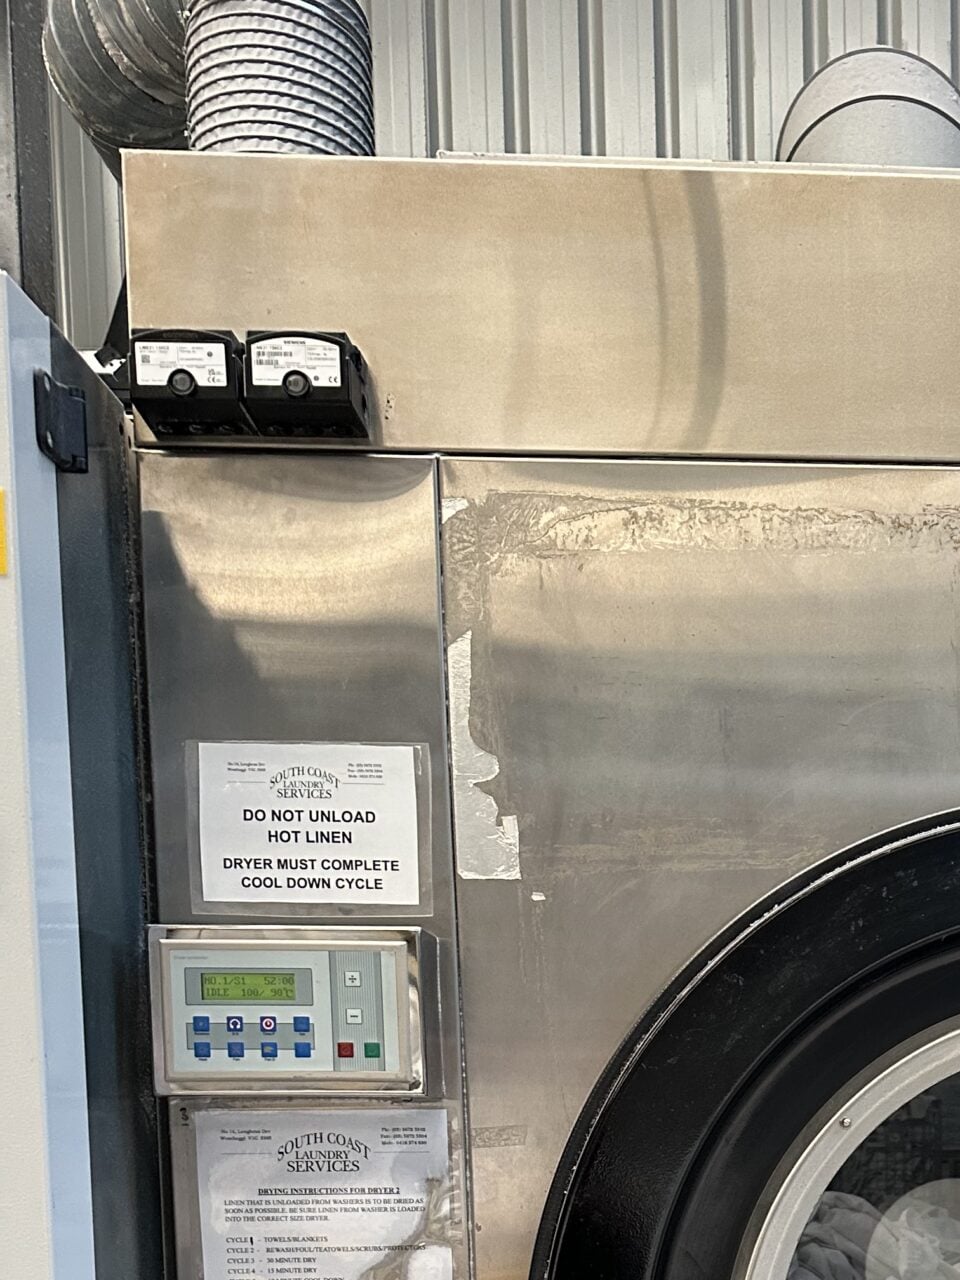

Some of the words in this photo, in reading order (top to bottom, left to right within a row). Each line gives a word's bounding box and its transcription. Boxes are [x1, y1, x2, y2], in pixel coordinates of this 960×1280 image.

[270, 766, 305, 790] SOUTH
[307, 766, 341, 789] COAST
[283, 780, 326, 789] LAUNDRY
[276, 788, 333, 799] SERVICES
[243, 808, 266, 822] DO
[271, 809, 304, 822] NOT
[309, 810, 376, 823] UNLOAD
[268, 830, 301, 843] HOT
[305, 830, 352, 844] LINEN
[223, 857, 273, 870] DRYER
[277, 858, 317, 870] MUST
[321, 859, 400, 872] COMPLETE
[241, 876, 283, 889] COOL
[286, 877, 331, 889] DOWN
[335, 878, 383, 890] CYCLE
[206, 987, 230, 997] IDLE
[277, 1132, 323, 1161] SOUTH
[327, 1132, 371, 1160] COAST
[295, 1150, 350, 1160] LAUNDRY
[286, 1160, 360, 1172] SERVICES
[290, 1187, 348, 1195] INSTRUCTIONS
[350, 1187, 366, 1195] FOR
